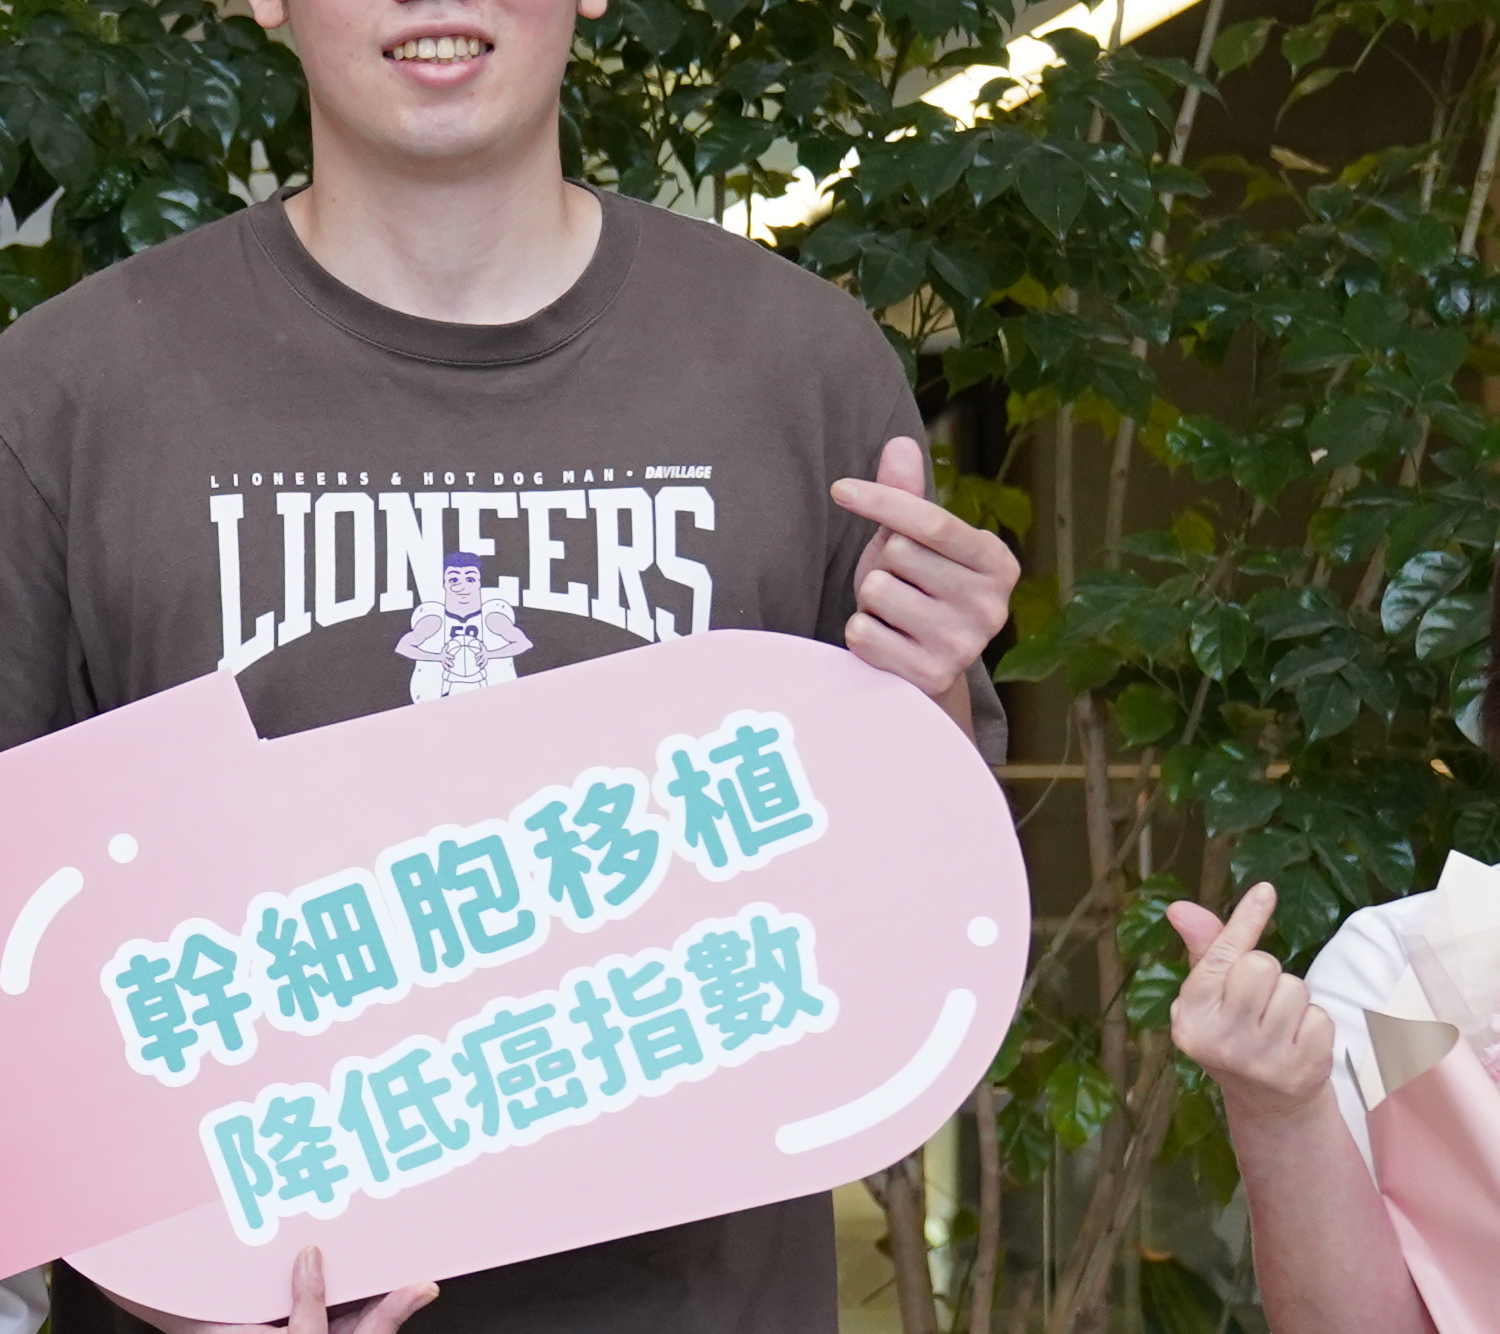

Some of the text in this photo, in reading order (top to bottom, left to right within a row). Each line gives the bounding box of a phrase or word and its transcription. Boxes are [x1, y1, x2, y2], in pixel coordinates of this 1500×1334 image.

[209, 486, 716, 677] LIONEERS
[210, 465, 713, 489] LIONEERS & HOT DOG MAN DAVILLAGE
[114, 723, 816, 1075] 幹細胞移植
[211, 913, 827, 1234] 降低癌指數
